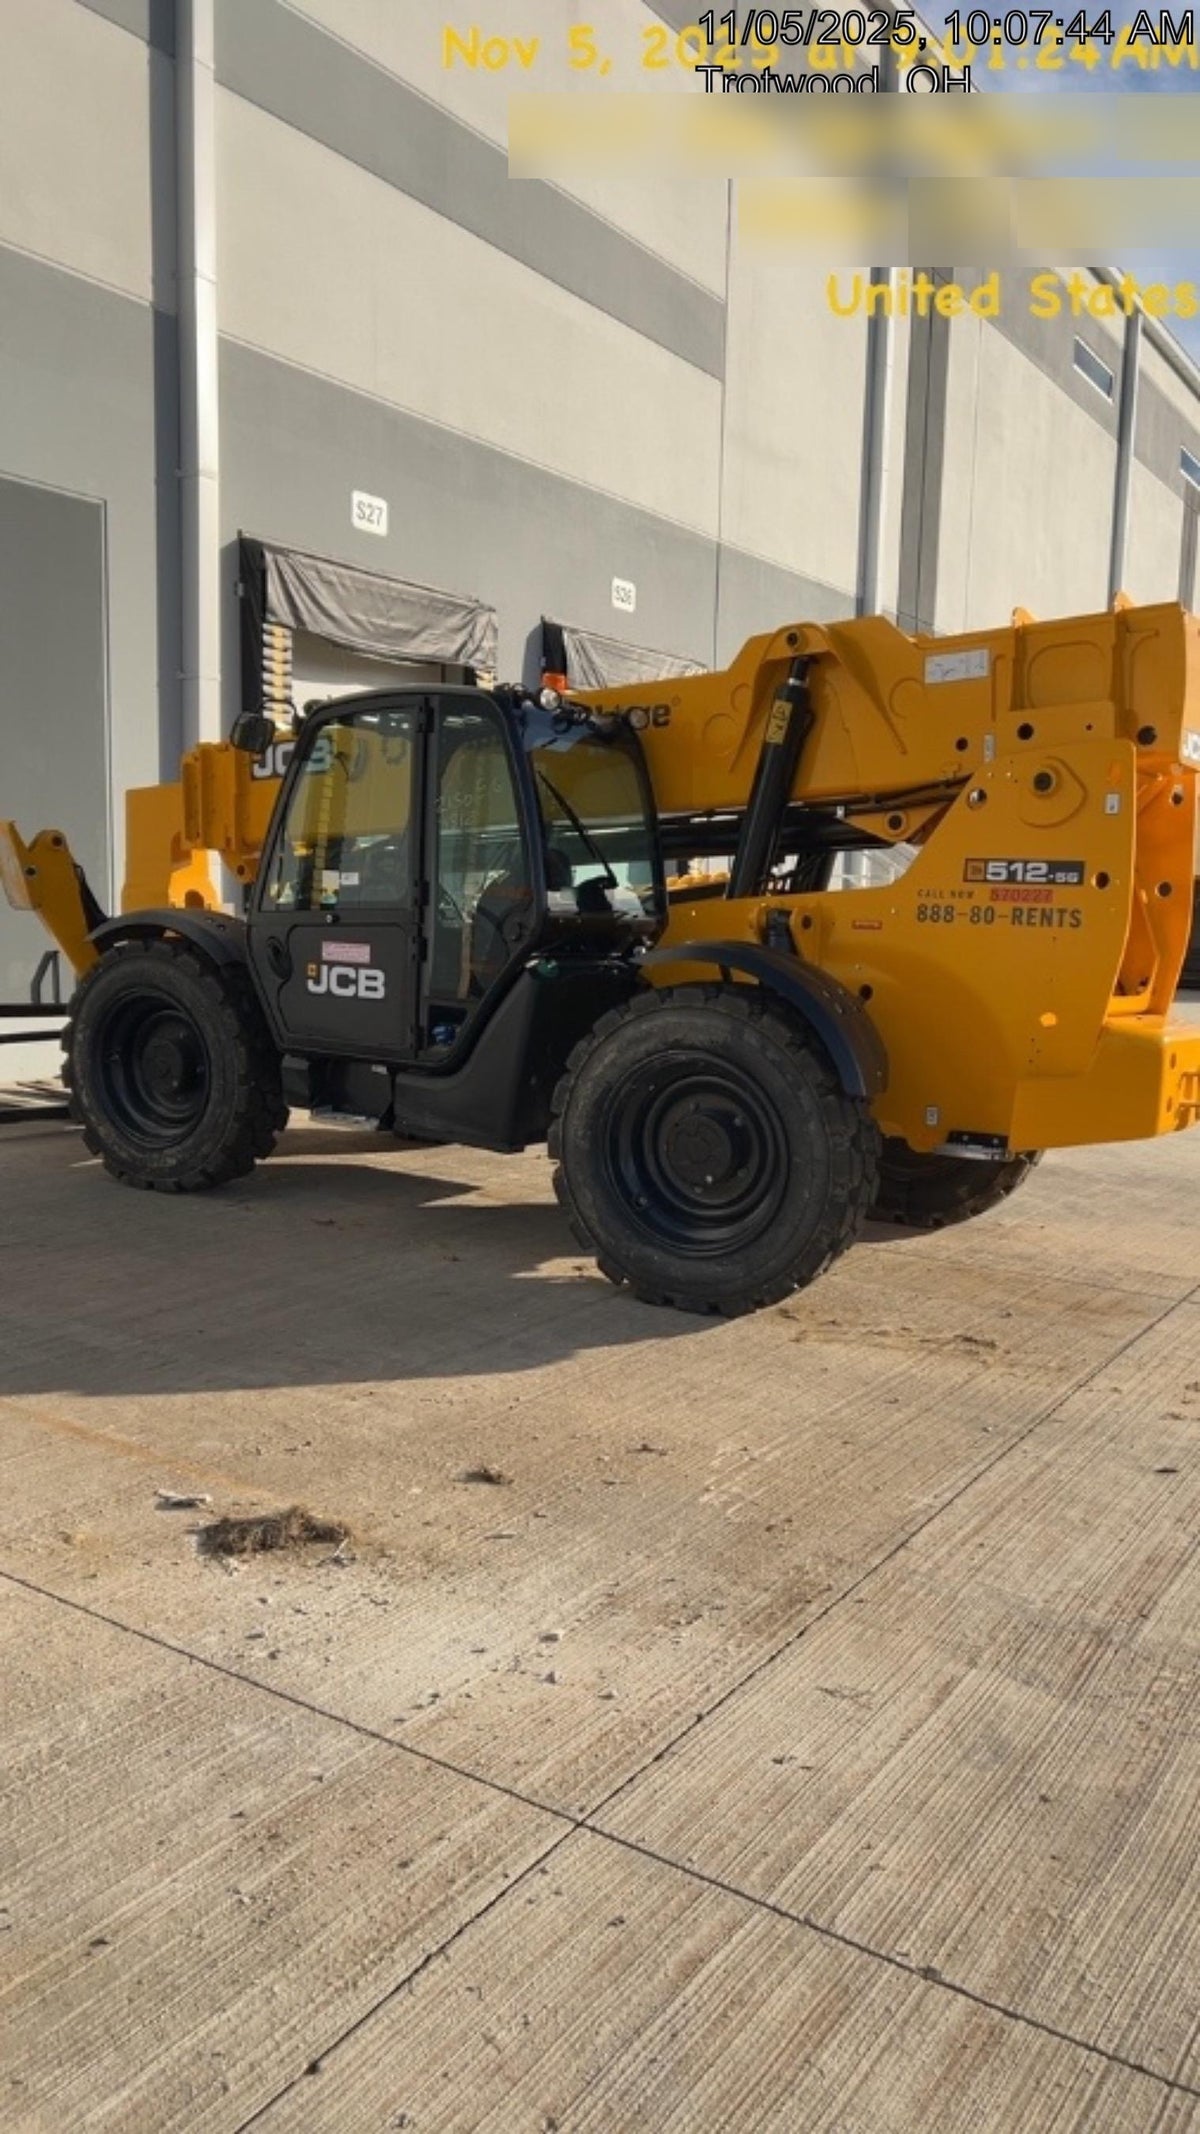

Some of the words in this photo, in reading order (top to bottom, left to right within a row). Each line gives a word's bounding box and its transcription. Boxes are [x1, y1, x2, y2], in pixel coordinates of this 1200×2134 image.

[356, 500, 382, 527] S27
[916, 903, 1082, 928] 888-80-RENTS
[307, 964, 385, 999] JCB
